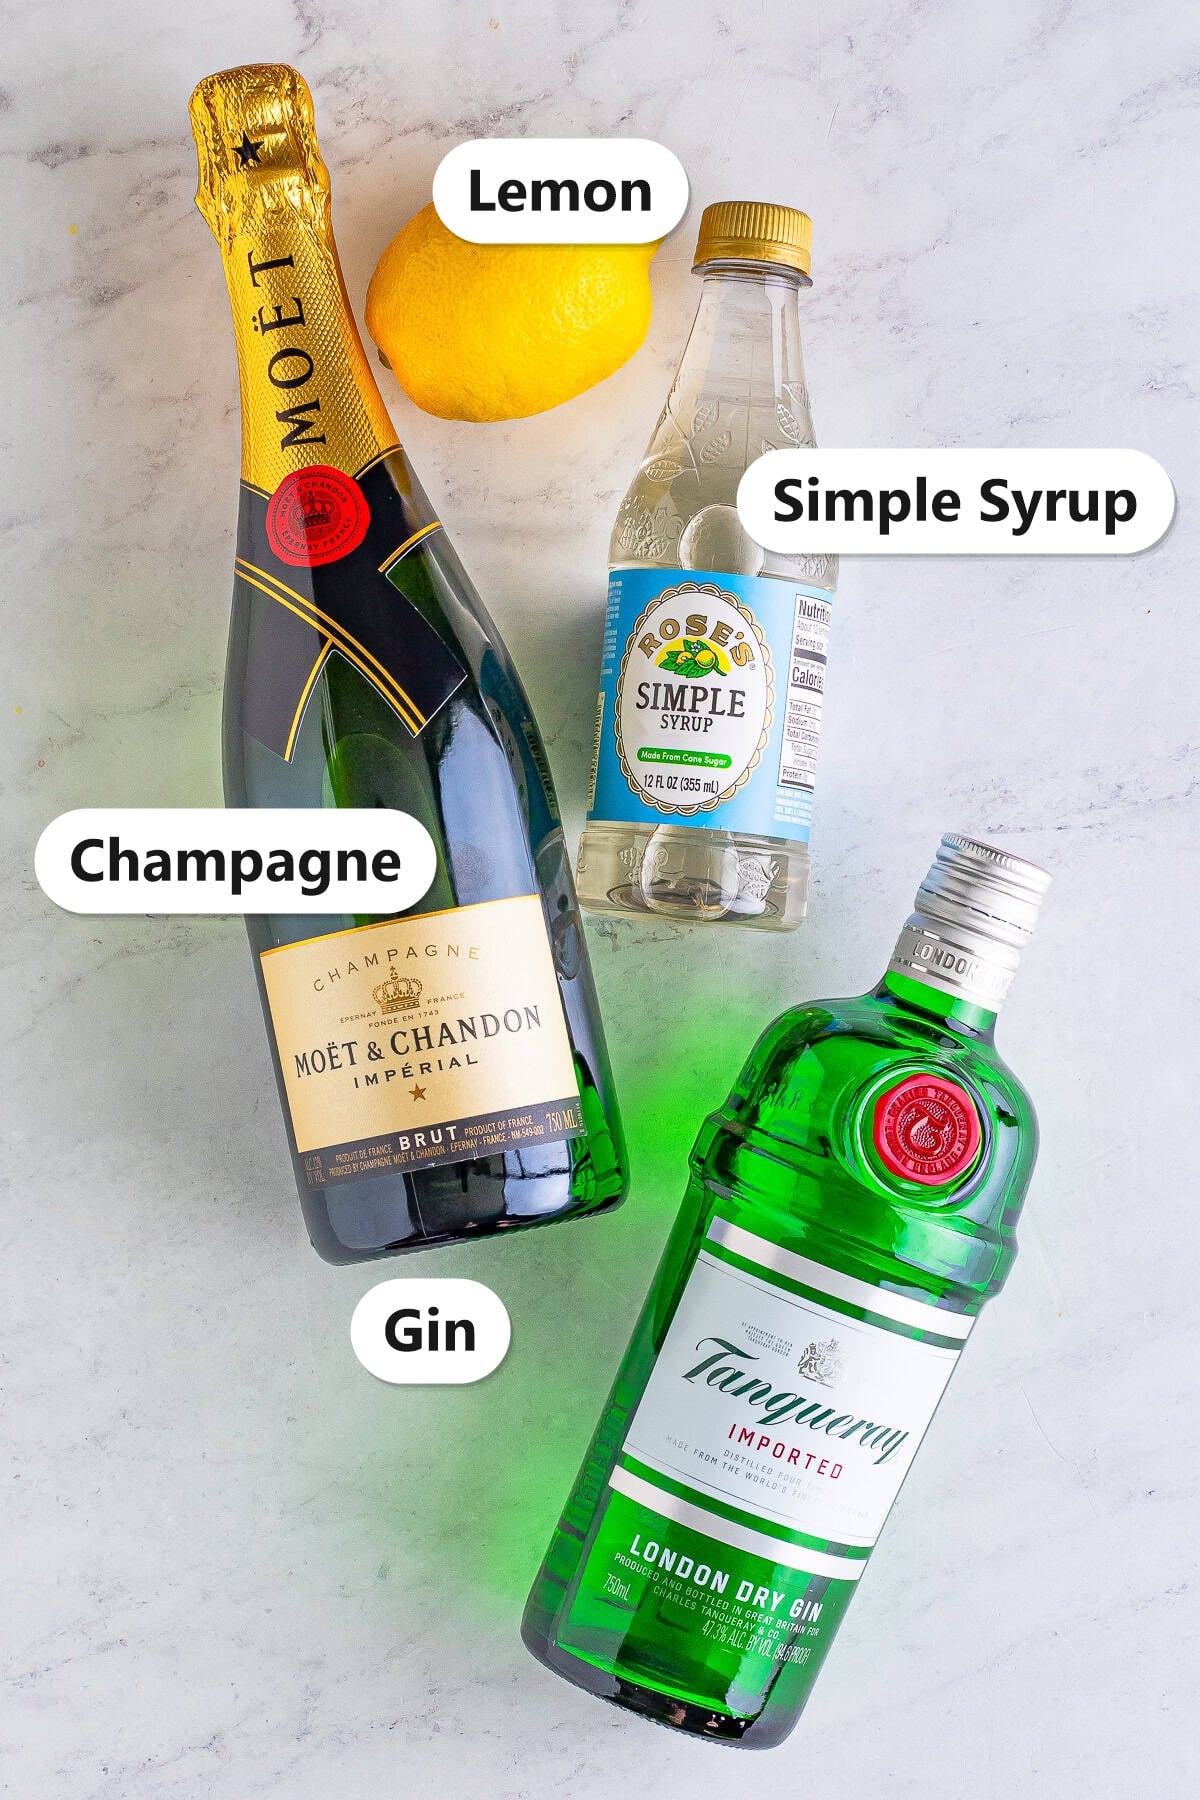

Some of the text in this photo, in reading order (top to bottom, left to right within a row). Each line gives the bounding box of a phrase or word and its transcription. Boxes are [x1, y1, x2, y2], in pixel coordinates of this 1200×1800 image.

[247, 250, 327, 451] MOËT
[638, 614, 755, 667] ROSE'S
[636, 682, 746, 718] SIMPLE
[660, 713, 714, 733] SYRUP
[641, 750, 728, 767] Made From Cane Sugar
[644, 774, 719, 795] 12 FL OZ (355 mL)
[313, 944, 482, 993] CHAMPAGNE
[402, 1014, 414, 1022] EN
[418, 1009, 439, 1019] 1743
[427, 992, 465, 1005] FRANCE
[294, 1005, 541, 1078] MOËT & CHANDON
[354, 1053, 478, 1089] IMPÉRIAL
[398, 1125, 457, 1151] BRUT
[464, 1114, 534, 1137] PRODUCT OF FRANCE
[545, 1112, 562, 1134] 750
[563, 1109, 578, 1130] ML
[335, 1151, 358, 1163] PRODUIT
[359, 1149, 367, 1159] DE
[368, 1143, 393, 1157] FRANCE
[359, 1155, 393, 1171] CHAMPAGNE
[416, 1145, 446, 1159] CHANDON
[483, 1131, 507, 1146] FRANCE
[682, 1337, 910, 1465] Tanqueray
[666, 1435, 689, 1451] MADE
[693, 1449, 718, 1465] FROM
[722, 1462, 740, 1475] THE
[745, 1472, 787, 1493] WORLD'S
[724, 1449, 773, 1475] DISTILLED
[777, 1471, 801, 1487] FOUR
[728, 1423, 843, 1480] IMPORTED
[602, 1572, 631, 1601] 750mL
[614, 1552, 820, 1637] PRODUCED AND BOTTLED IN GREAT BRITAIN FOR
[629, 1534, 824, 1623] LONDON DRY GIN
[653, 1585, 780, 1640] CHARLES TANQUERAY & CO.
[702, 1619, 728, 1642] 47.3%
[727, 1628, 747, 1649] ALC.
[745, 1634, 760, 1651] BY
